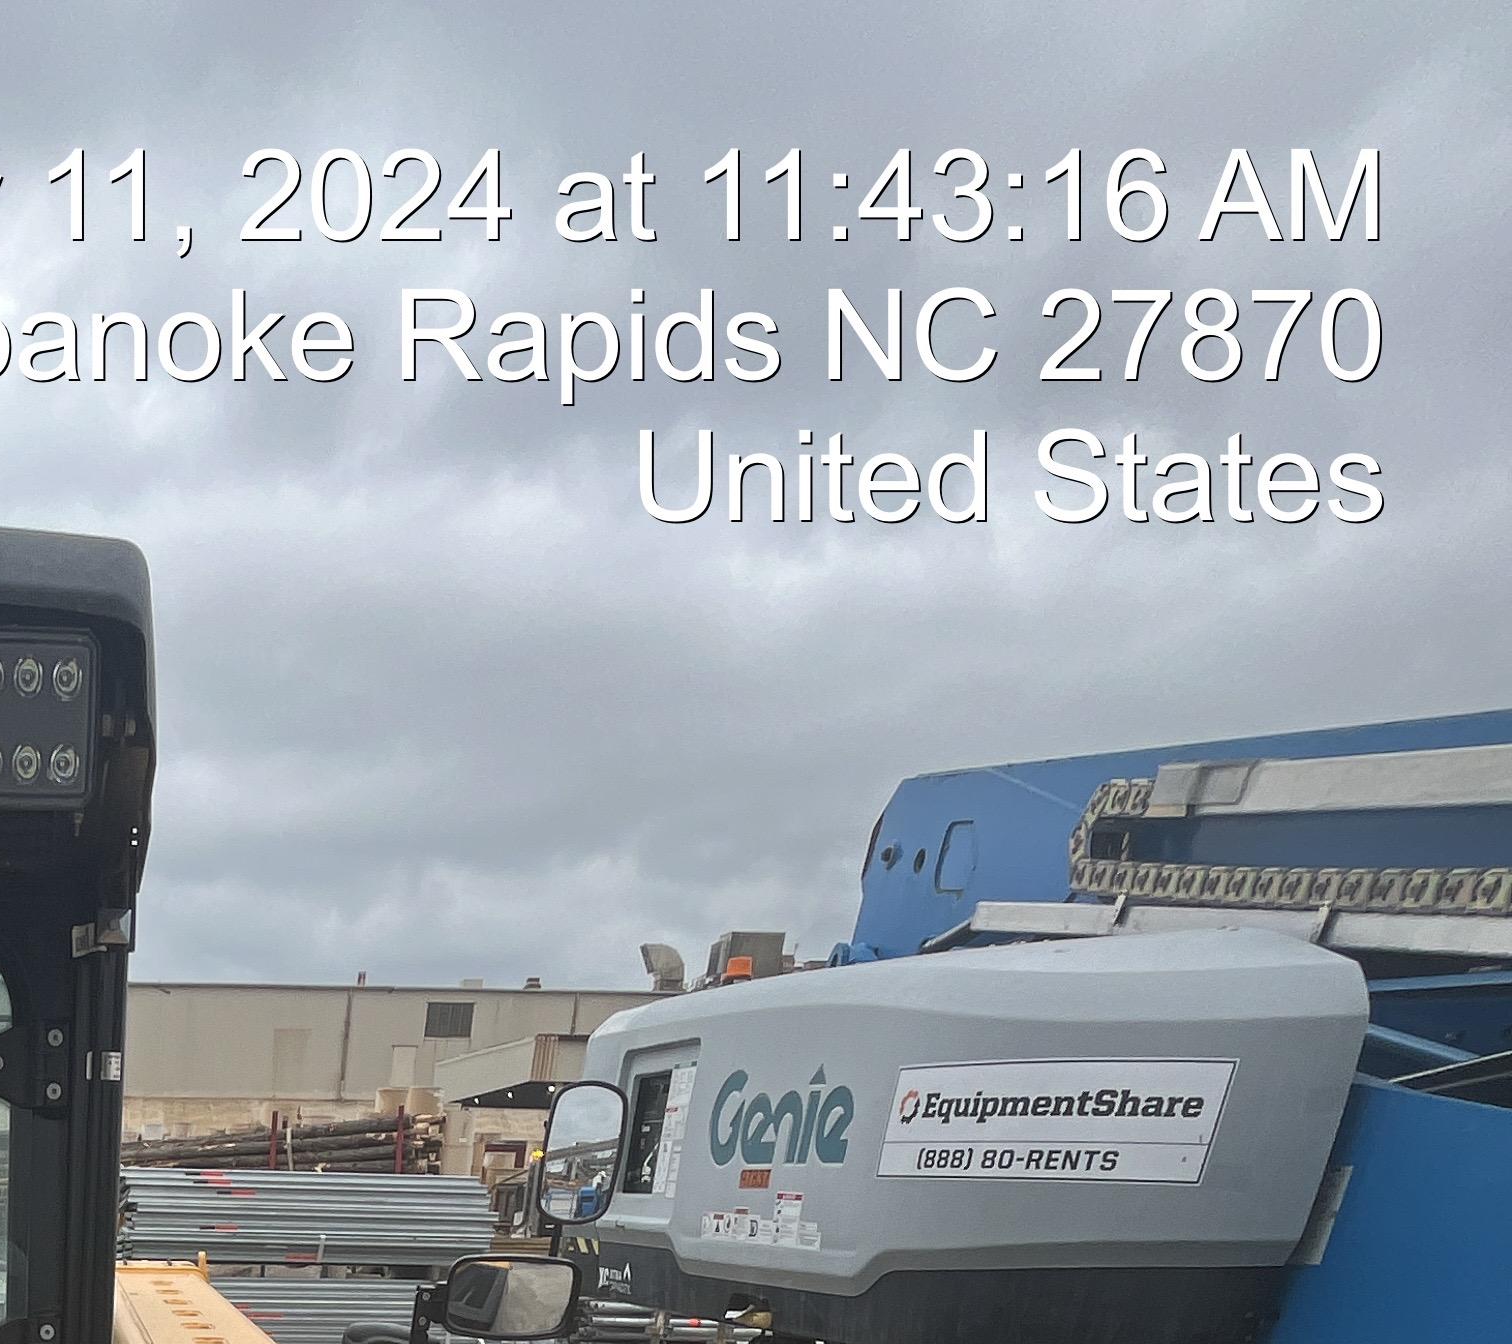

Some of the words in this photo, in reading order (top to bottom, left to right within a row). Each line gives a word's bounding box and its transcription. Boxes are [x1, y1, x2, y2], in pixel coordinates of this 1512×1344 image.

[708, 1063, 855, 1167] Genie
[921, 1088, 1205, 1124] EquipmentShare
[915, 1147, 974, 1171] (888)
[981, 1149, 1120, 1172] 80-RENTS
